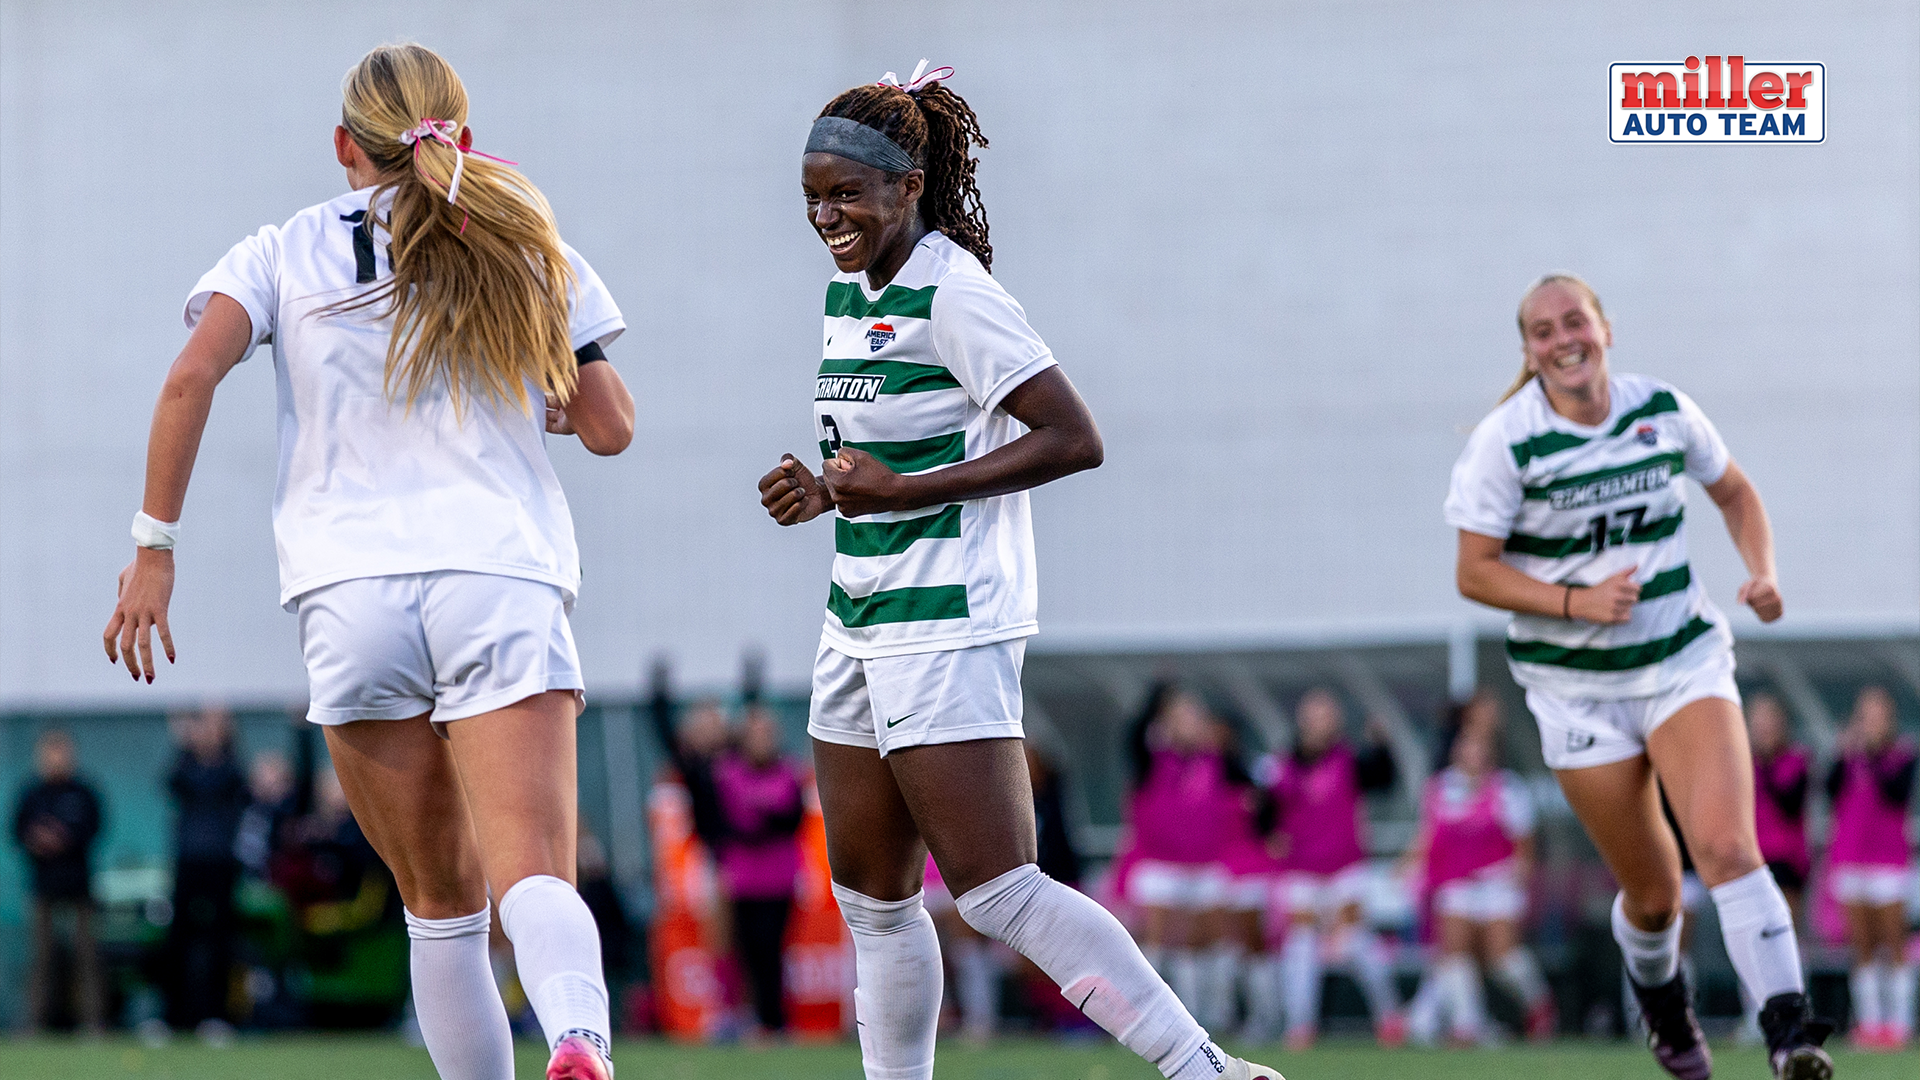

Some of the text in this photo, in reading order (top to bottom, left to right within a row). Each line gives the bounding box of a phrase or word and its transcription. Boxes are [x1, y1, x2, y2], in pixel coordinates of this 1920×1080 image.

[864, 329, 897, 341] AMERICA
[870, 337, 889, 345] EAST
[1590, 506, 1648, 552] 17
